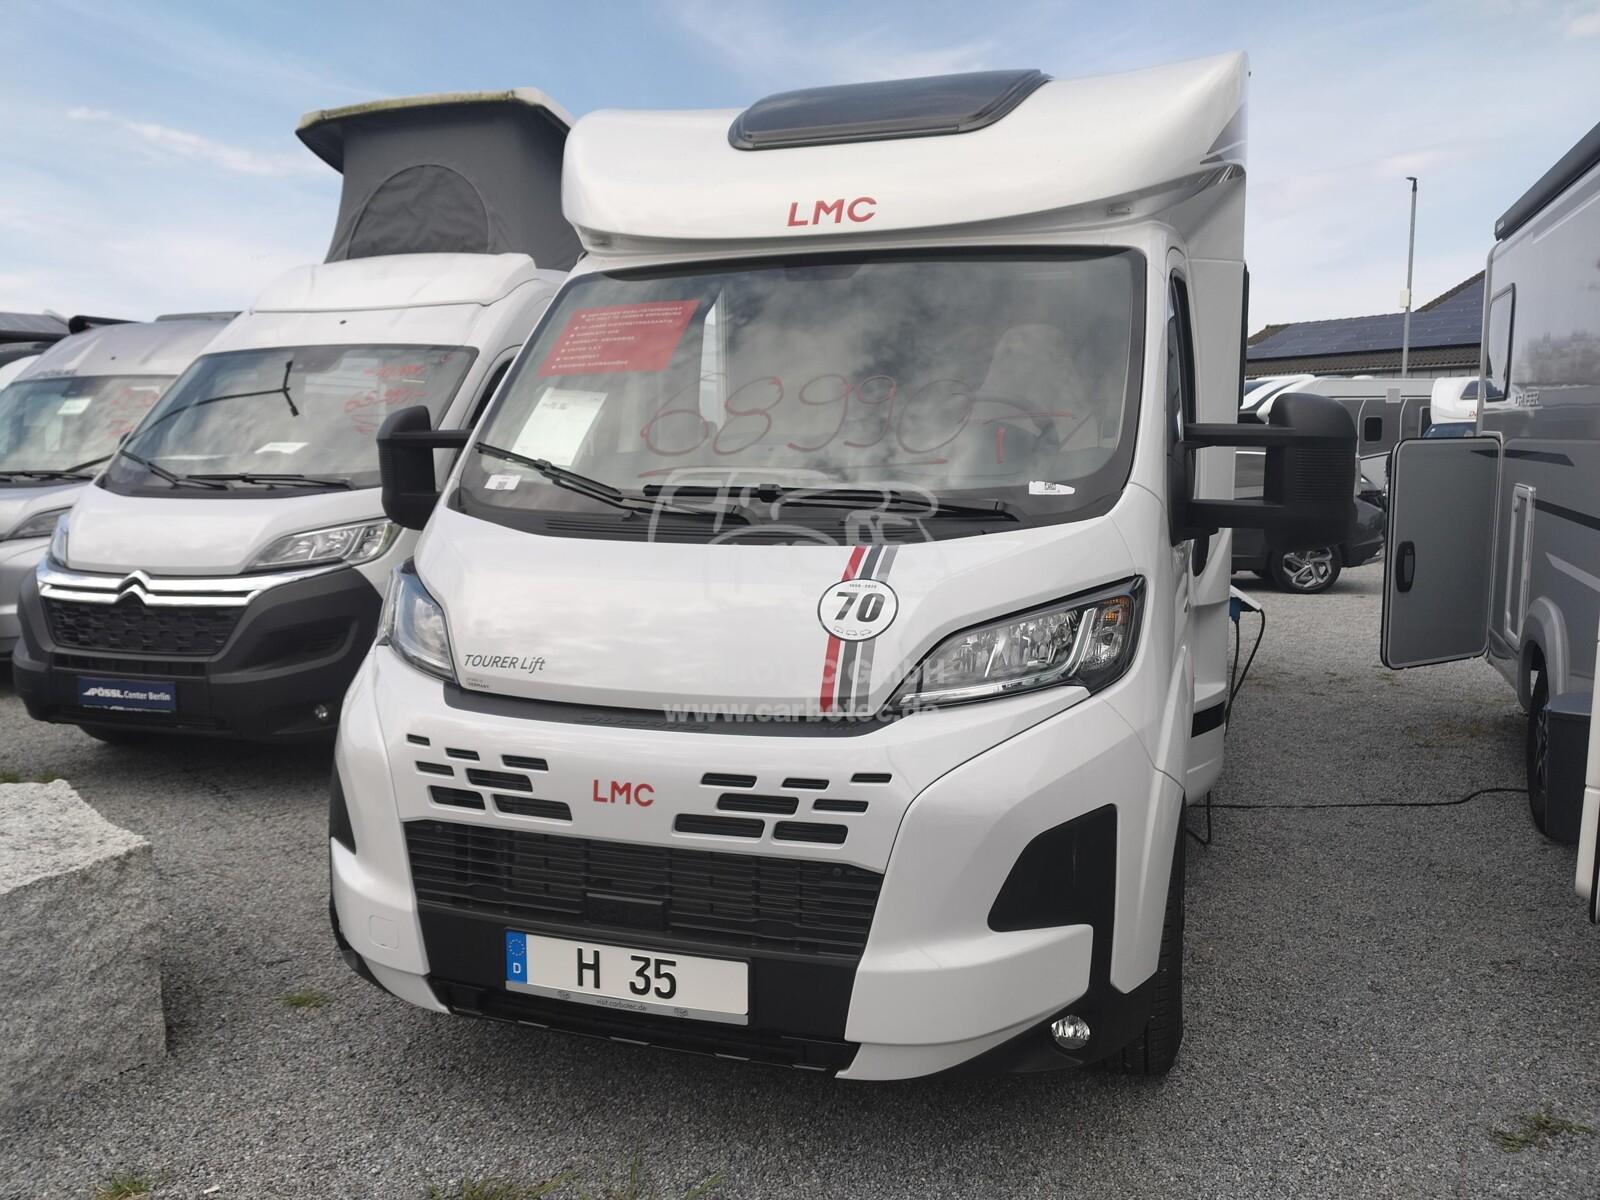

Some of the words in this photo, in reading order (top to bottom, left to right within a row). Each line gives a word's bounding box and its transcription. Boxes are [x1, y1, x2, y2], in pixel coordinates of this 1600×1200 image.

[787, 196, 877, 226] LMC
[834, 591, 886, 623] 70
[464, 654, 519, 669] TOURER
[520, 656, 546, 674] Lift
[124, 690, 147, 700] Center
[148, 692, 171, 701] Berlin
[593, 779, 655, 807] LMC
[512, 962, 522, 974] D
[577, 948, 601, 989] H
[629, 955, 677, 999] 35
